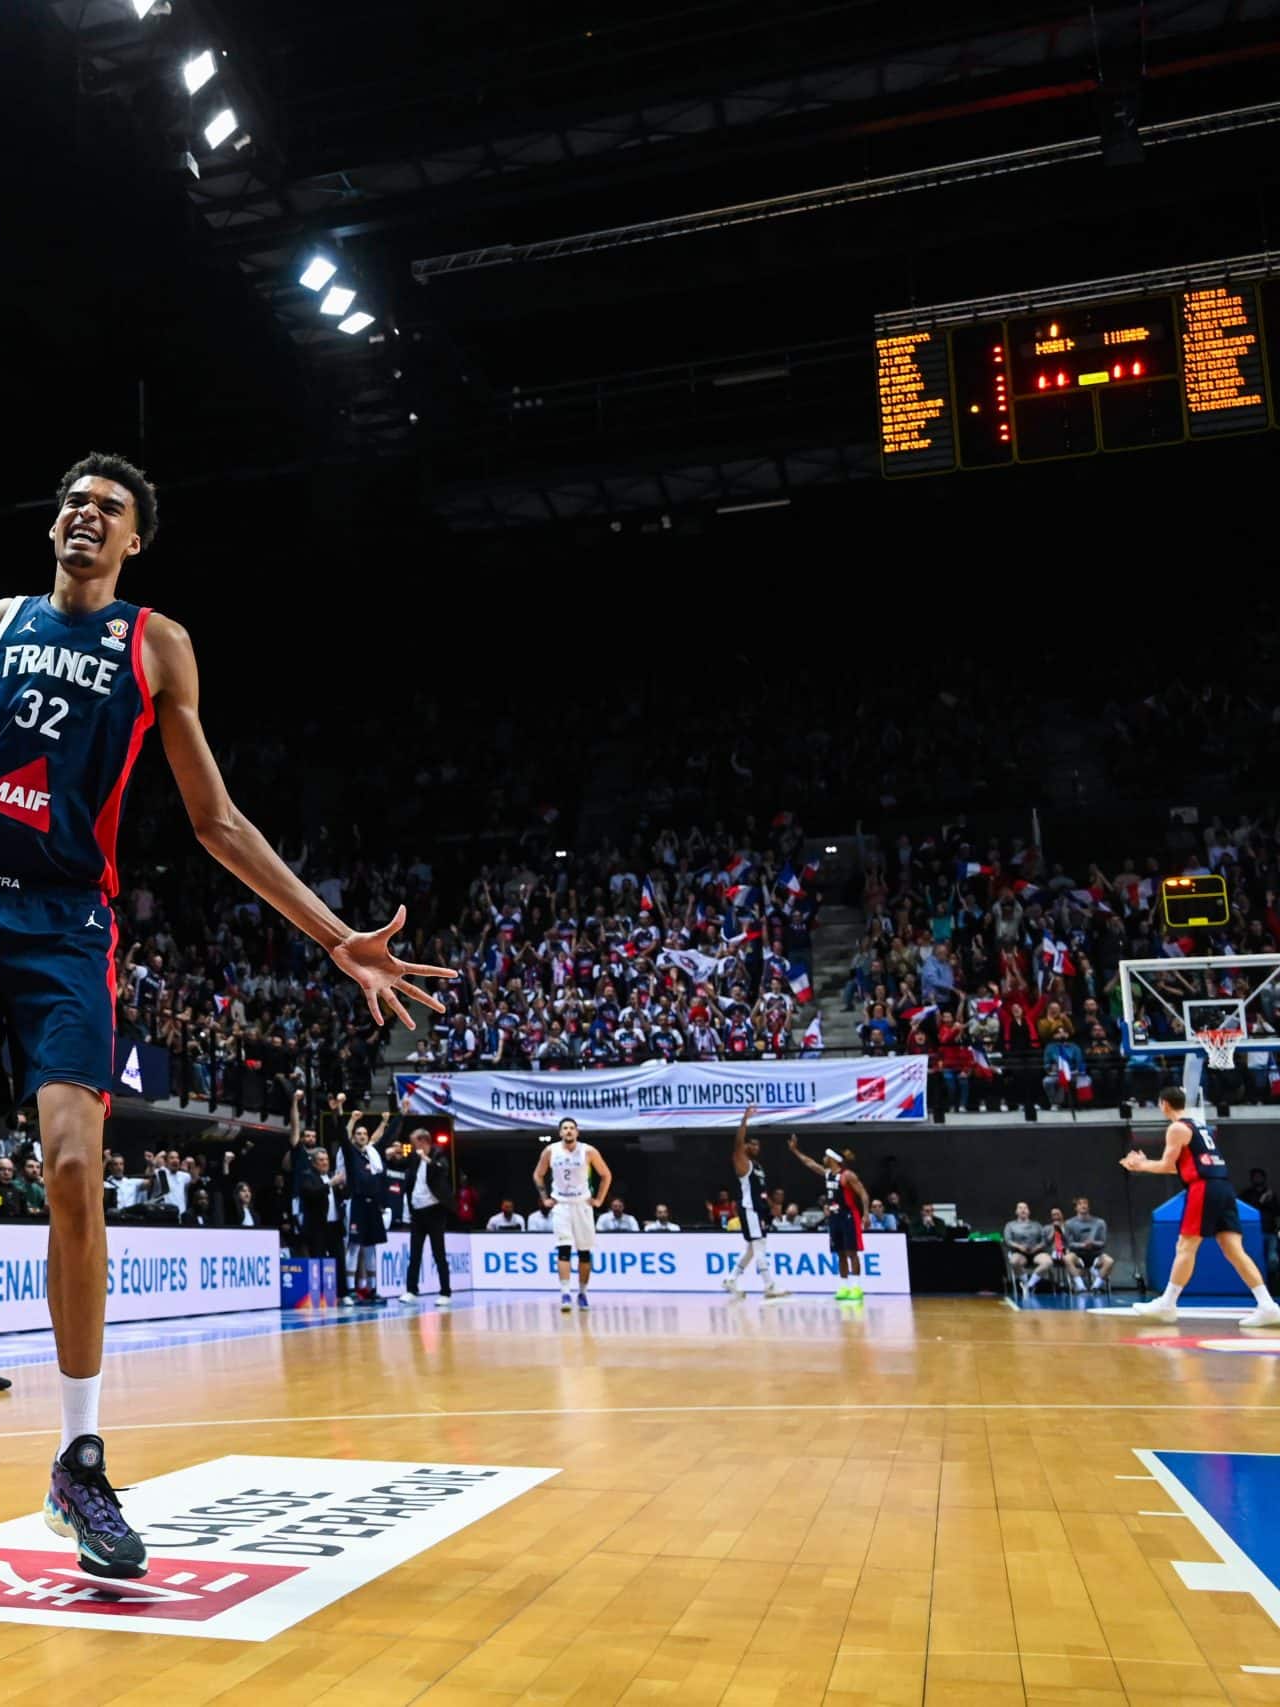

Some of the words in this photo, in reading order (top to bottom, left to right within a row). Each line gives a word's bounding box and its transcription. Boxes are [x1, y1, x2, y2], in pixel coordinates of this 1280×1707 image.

[2, 644, 120, 695] FRANCE
[15, 689, 69, 740] 32
[491, 1088, 501, 1110] À
[505, 1089, 555, 1111] COEUR
[560, 1087, 633, 1111] VAILLANT,
[638, 1085, 671, 1107] RIEN
[121, 1248, 187, 1296] ÉQUIPES
[200, 1256, 217, 1290] DE
[222, 1256, 271, 1288] FRANCE
[484, 1252, 538, 1274] DES
[144, 1489, 335, 1548] CAISSE
